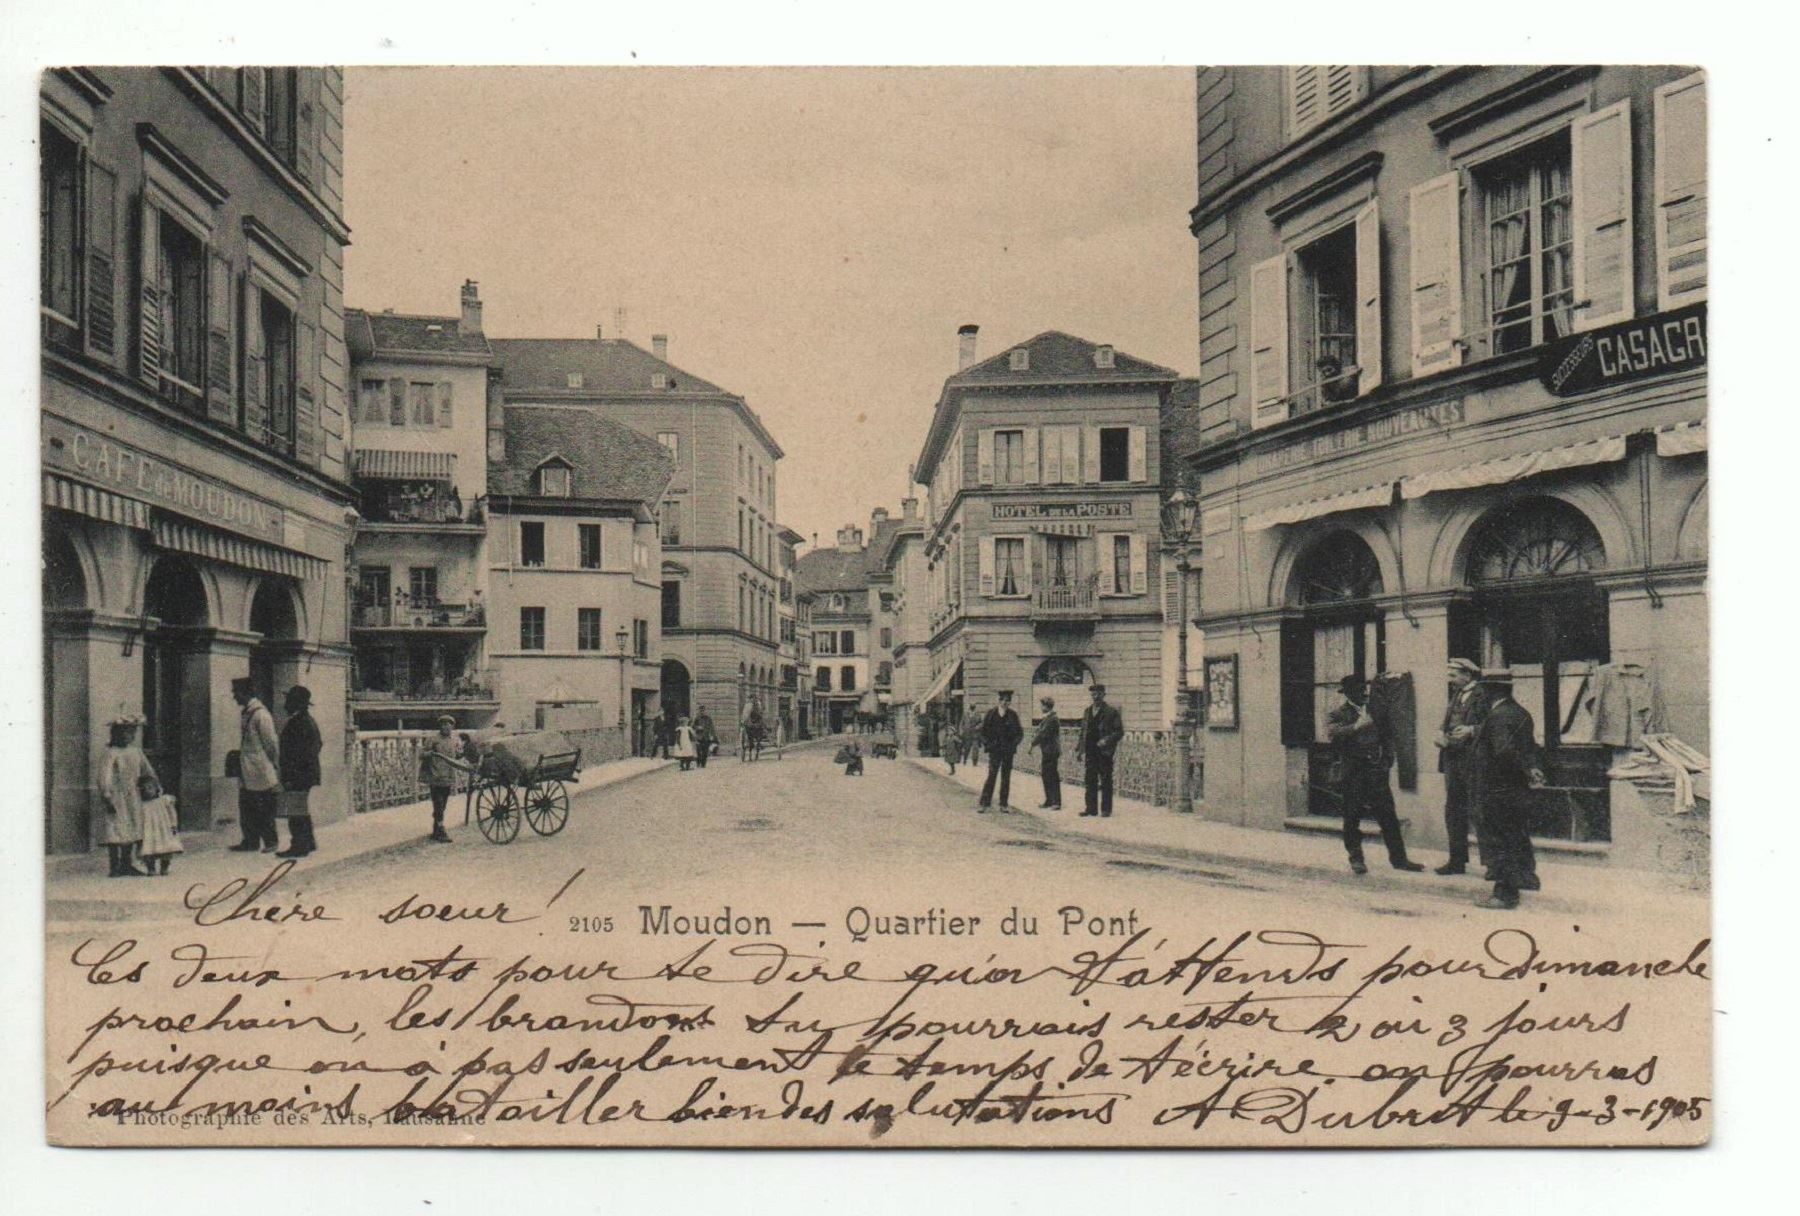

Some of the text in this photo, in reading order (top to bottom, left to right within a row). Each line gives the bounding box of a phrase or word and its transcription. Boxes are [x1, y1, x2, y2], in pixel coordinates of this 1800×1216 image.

[174, 469, 267, 530] MOUDON
[994, 504, 1047, 518] HOTEL
[1076, 502, 1132, 517] POSTE
[316, 944, 490, 982] mots
[653, 938, 714, 983] te
[730, 940, 873, 985] dire
[386, 983, 455, 1032] les
[746, 991, 835, 1035] tu
[1124, 991, 1292, 1034] rester
[46, 1042, 275, 1111] puisque
[308, 1057, 374, 1077] on
[556, 1030, 833, 1075] seulement
[1066, 1039, 1113, 1082] de
[667, 1076, 775, 1123] bien
[779, 1080, 835, 1125] des
